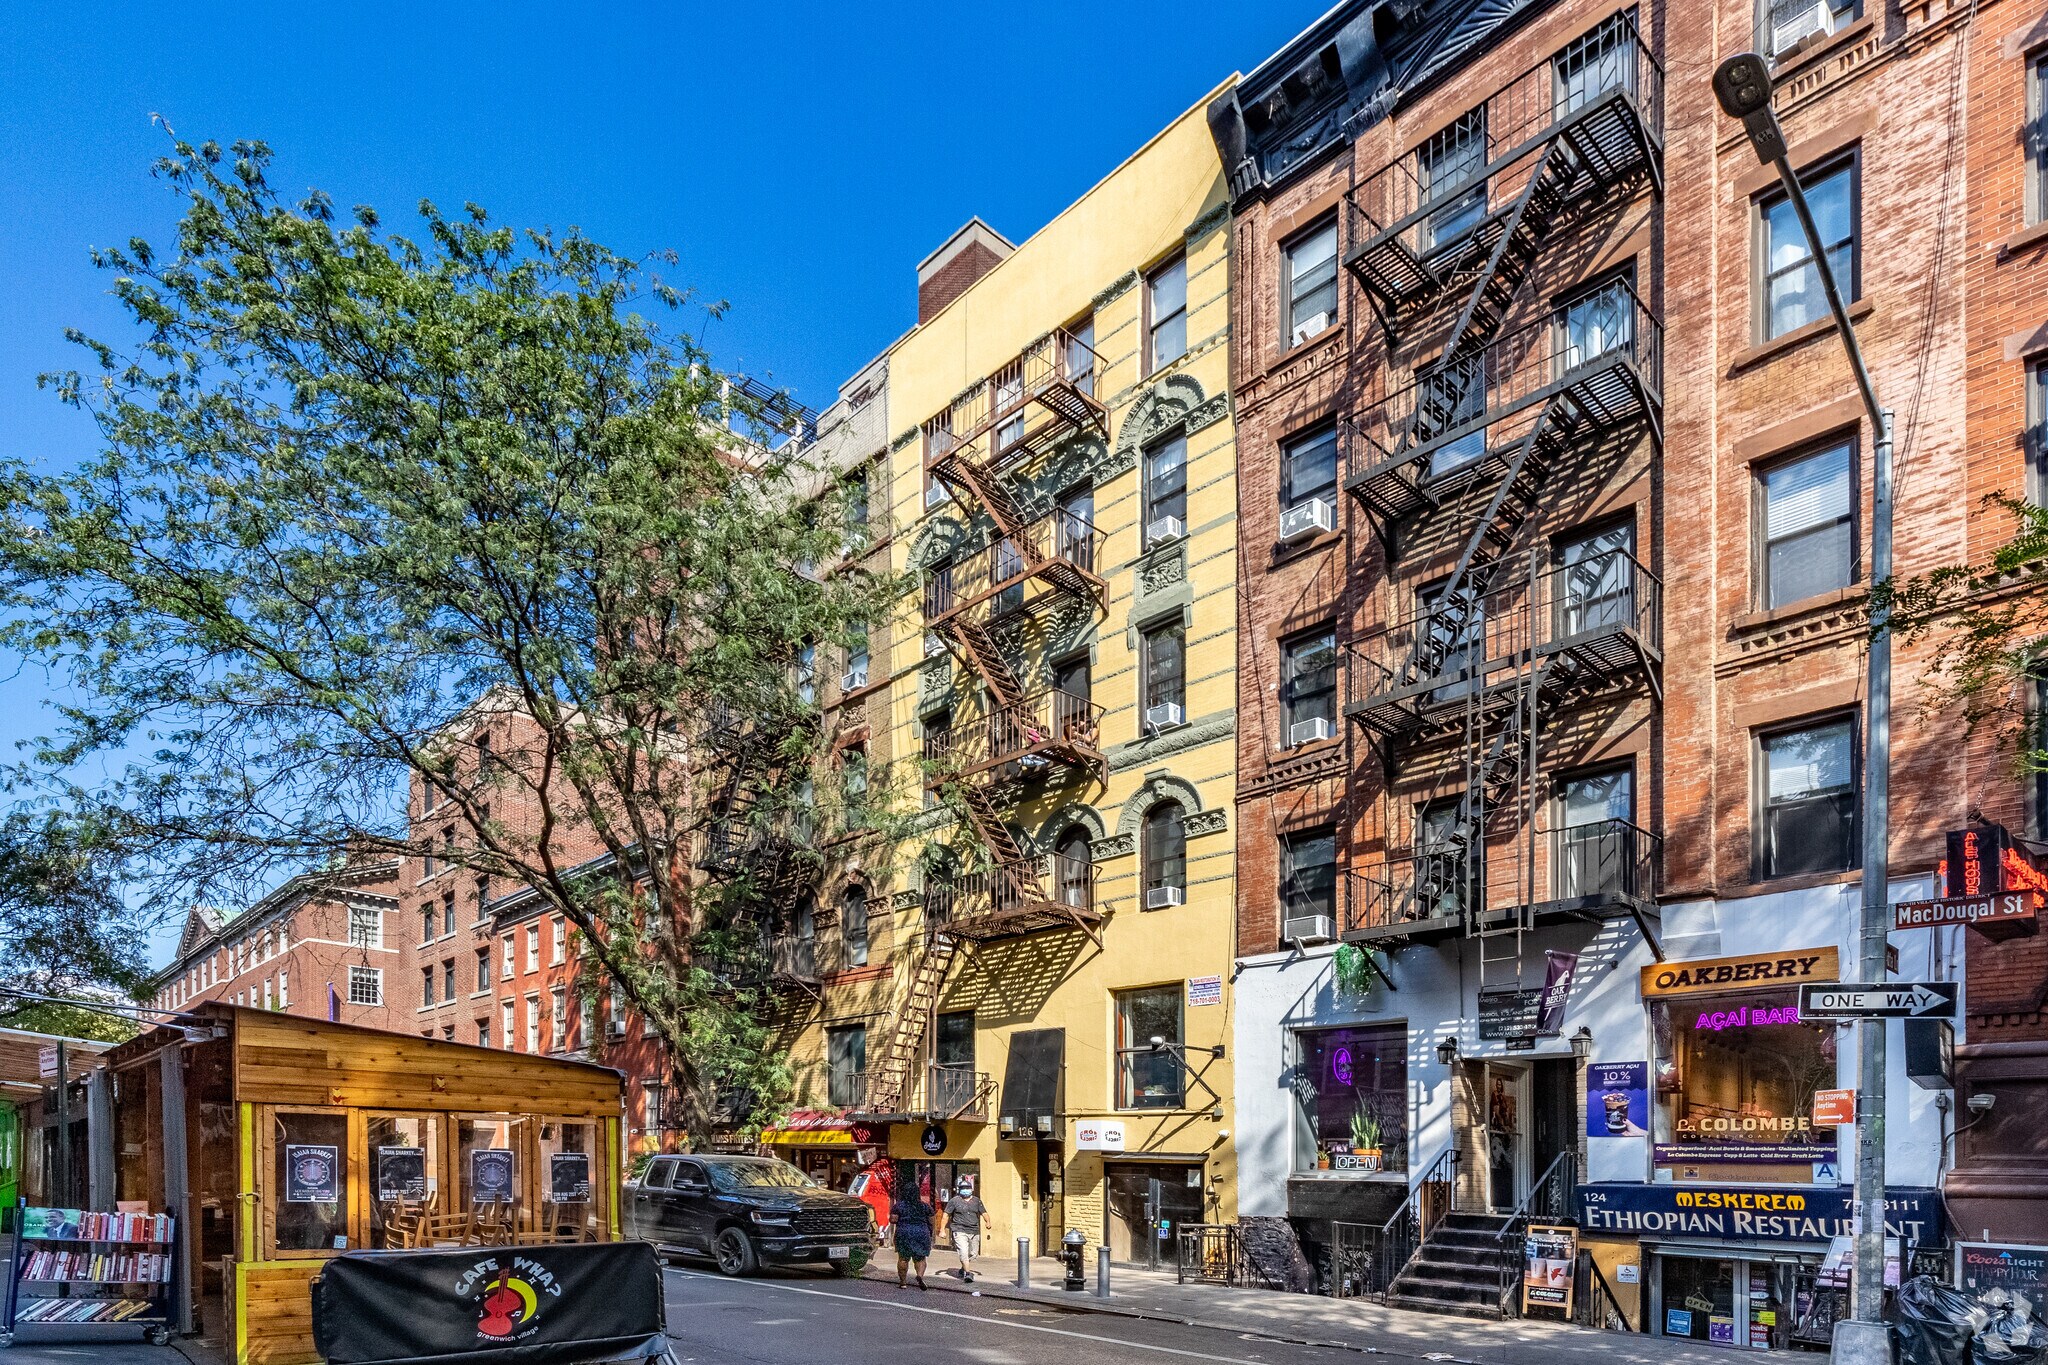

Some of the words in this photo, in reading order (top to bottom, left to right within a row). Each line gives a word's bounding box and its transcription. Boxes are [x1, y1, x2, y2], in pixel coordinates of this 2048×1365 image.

[1898, 897, 1995, 924] MacDougal
[2003, 894, 2024, 914] St
[1655, 956, 1820, 989] OAKBERRY
[1551, 986, 1565, 996] OAK
[1545, 994, 1568, 1005] BERRY
[1822, 994, 1865, 1008] ONE
[1886, 993, 1933, 1007] WAY
[1695, 1007, 1748, 1030] AÇAÍ
[1752, 1007, 1800, 1025] BAR
[1603, 1071, 1618, 1081] 10
[1620, 1071, 1631, 1080] %
[1825, 1093, 1848, 1101] STOPPING
[1816, 1102, 1836, 1110] Anytime
[1018, 1127, 1033, 1137] 126
[1675, 1119, 1697, 1132] La
[1701, 1117, 1811, 1132] COLOMBE
[1338, 1157, 1375, 1168] OPEN
[1816, 1163, 1835, 1178] A
[1583, 1193, 1607, 1202] 124
[1676, 1192, 1806, 1212] MESKEREM
[1585, 1205, 1725, 1233] ETHIOPIAN
[1733, 1210, 1925, 1240] RESTAURNT
[1966, 1253, 2006, 1265] Coors
[2007, 1259, 2045, 1267] LIGHT
[454, 1258, 500, 1296] CAFE
[514, 1256, 562, 1297] WHA?
[1687, 1299, 1712, 1310] OPEN
[476, 1331, 516, 1342] greenwich
[517, 1326, 539, 1340] village
